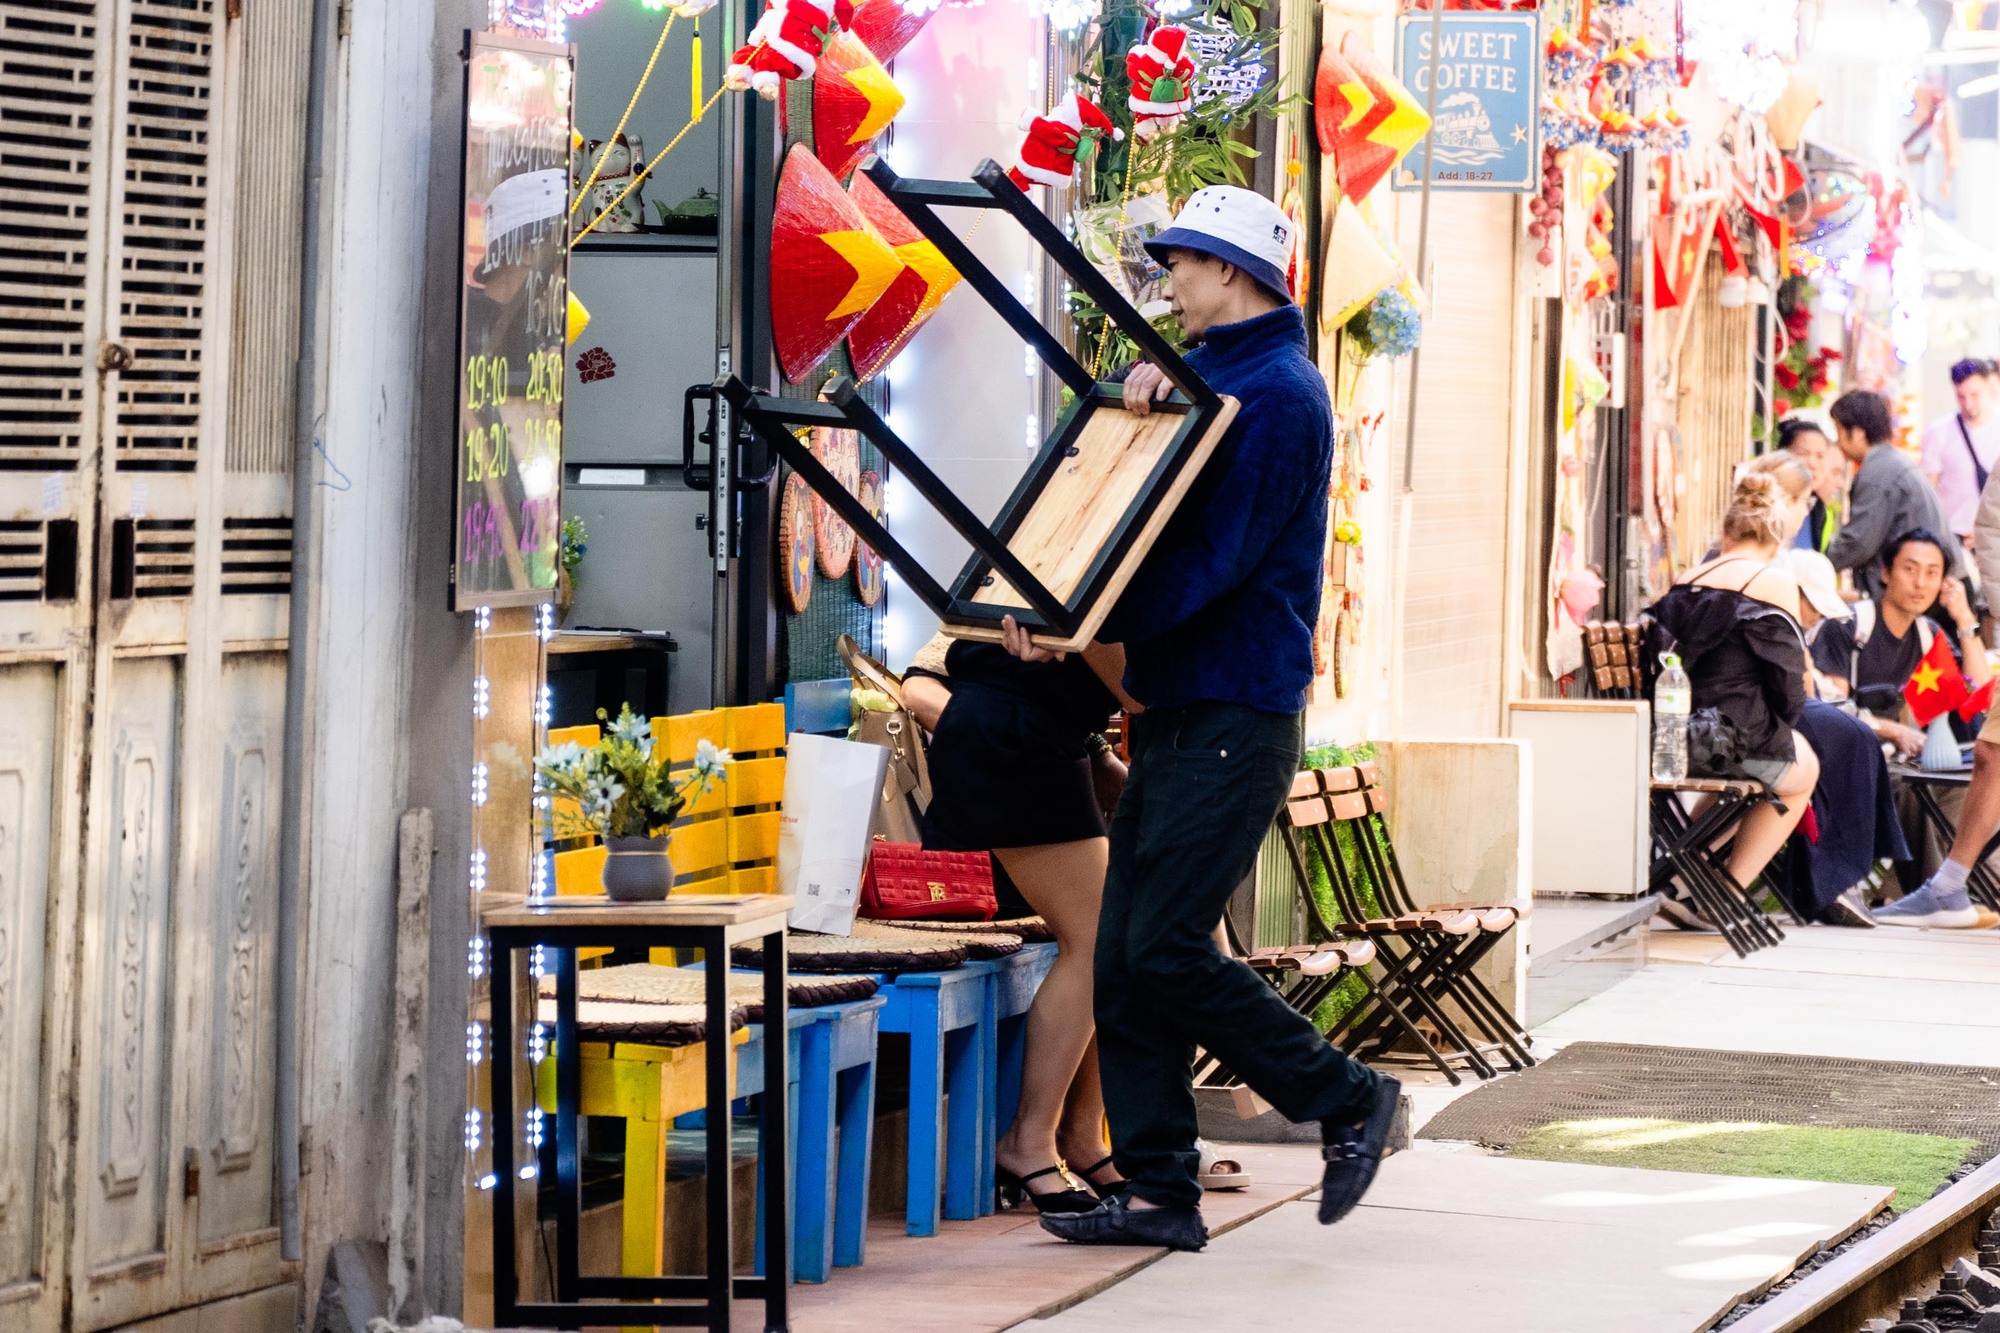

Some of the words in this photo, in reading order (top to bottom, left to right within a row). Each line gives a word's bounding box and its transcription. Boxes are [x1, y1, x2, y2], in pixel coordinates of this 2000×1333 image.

[1418, 31, 1517, 60] SWEET
[1414, 63, 1517, 93] COFFEE
[1437, 171, 1462, 180] Add:
[1465, 171, 1493, 180] 18-27
[467, 355, 509, 410] 19:10
[526, 350, 563, 405] 20:50
[466, 422, 509, 482] 19:20
